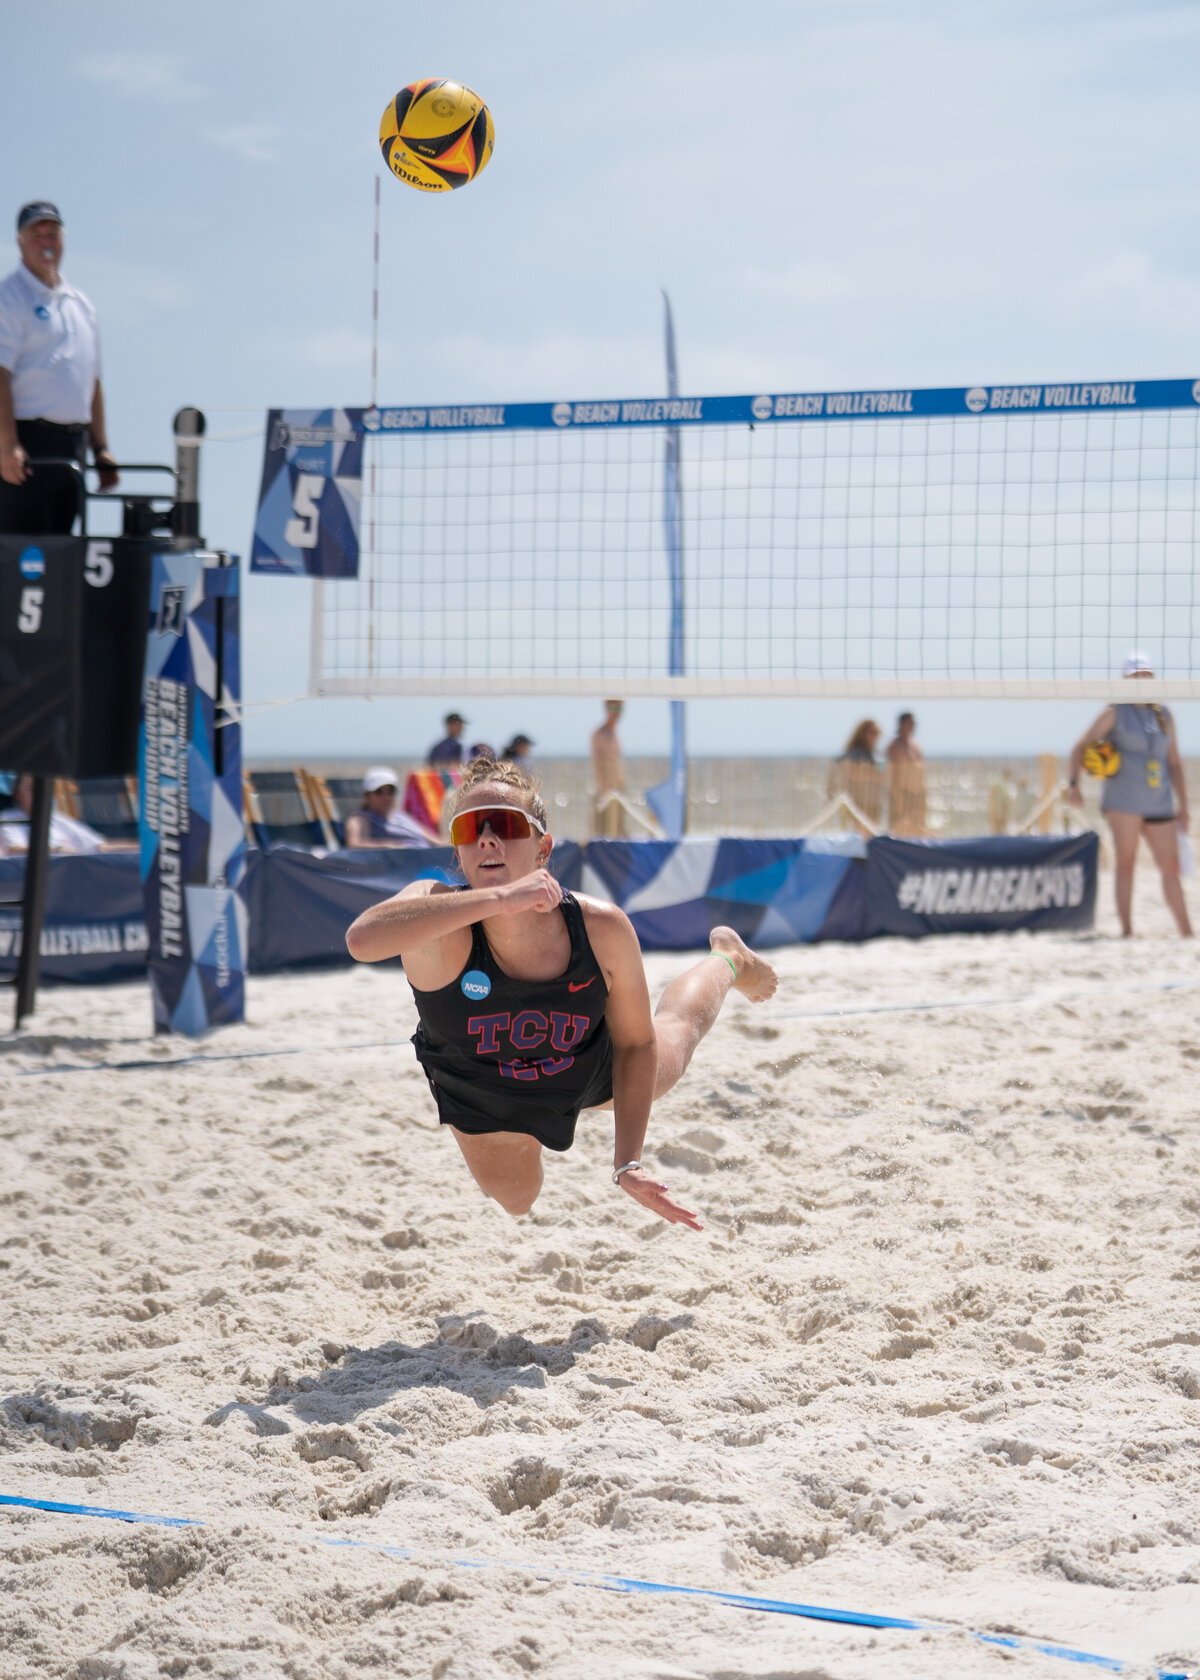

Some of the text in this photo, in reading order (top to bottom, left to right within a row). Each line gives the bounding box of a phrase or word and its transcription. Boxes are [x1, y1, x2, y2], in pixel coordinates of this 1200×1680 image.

[394, 163, 443, 189] Wilson
[573, 403, 620, 424] BEACH
[621, 400, 703, 422] VOLLEYBALL
[774, 395, 825, 417] BEACH
[825, 392, 914, 414] VOLLEYBALL
[990, 382, 1137, 409] BEACH VOLLEYBALL
[382, 407, 505, 429] BEACH VOLLEYBALL
[284, 474, 327, 549] 5
[84, 540, 115, 588] 5
[17, 586, 45, 634] 5
[144, 676, 161, 832] CHAMPIONSHIP
[158, 679, 183, 959] BEACH VOLLEYBALL
[464, 982, 489, 995] NCAA
[468, 1010, 590, 1055] TCU
